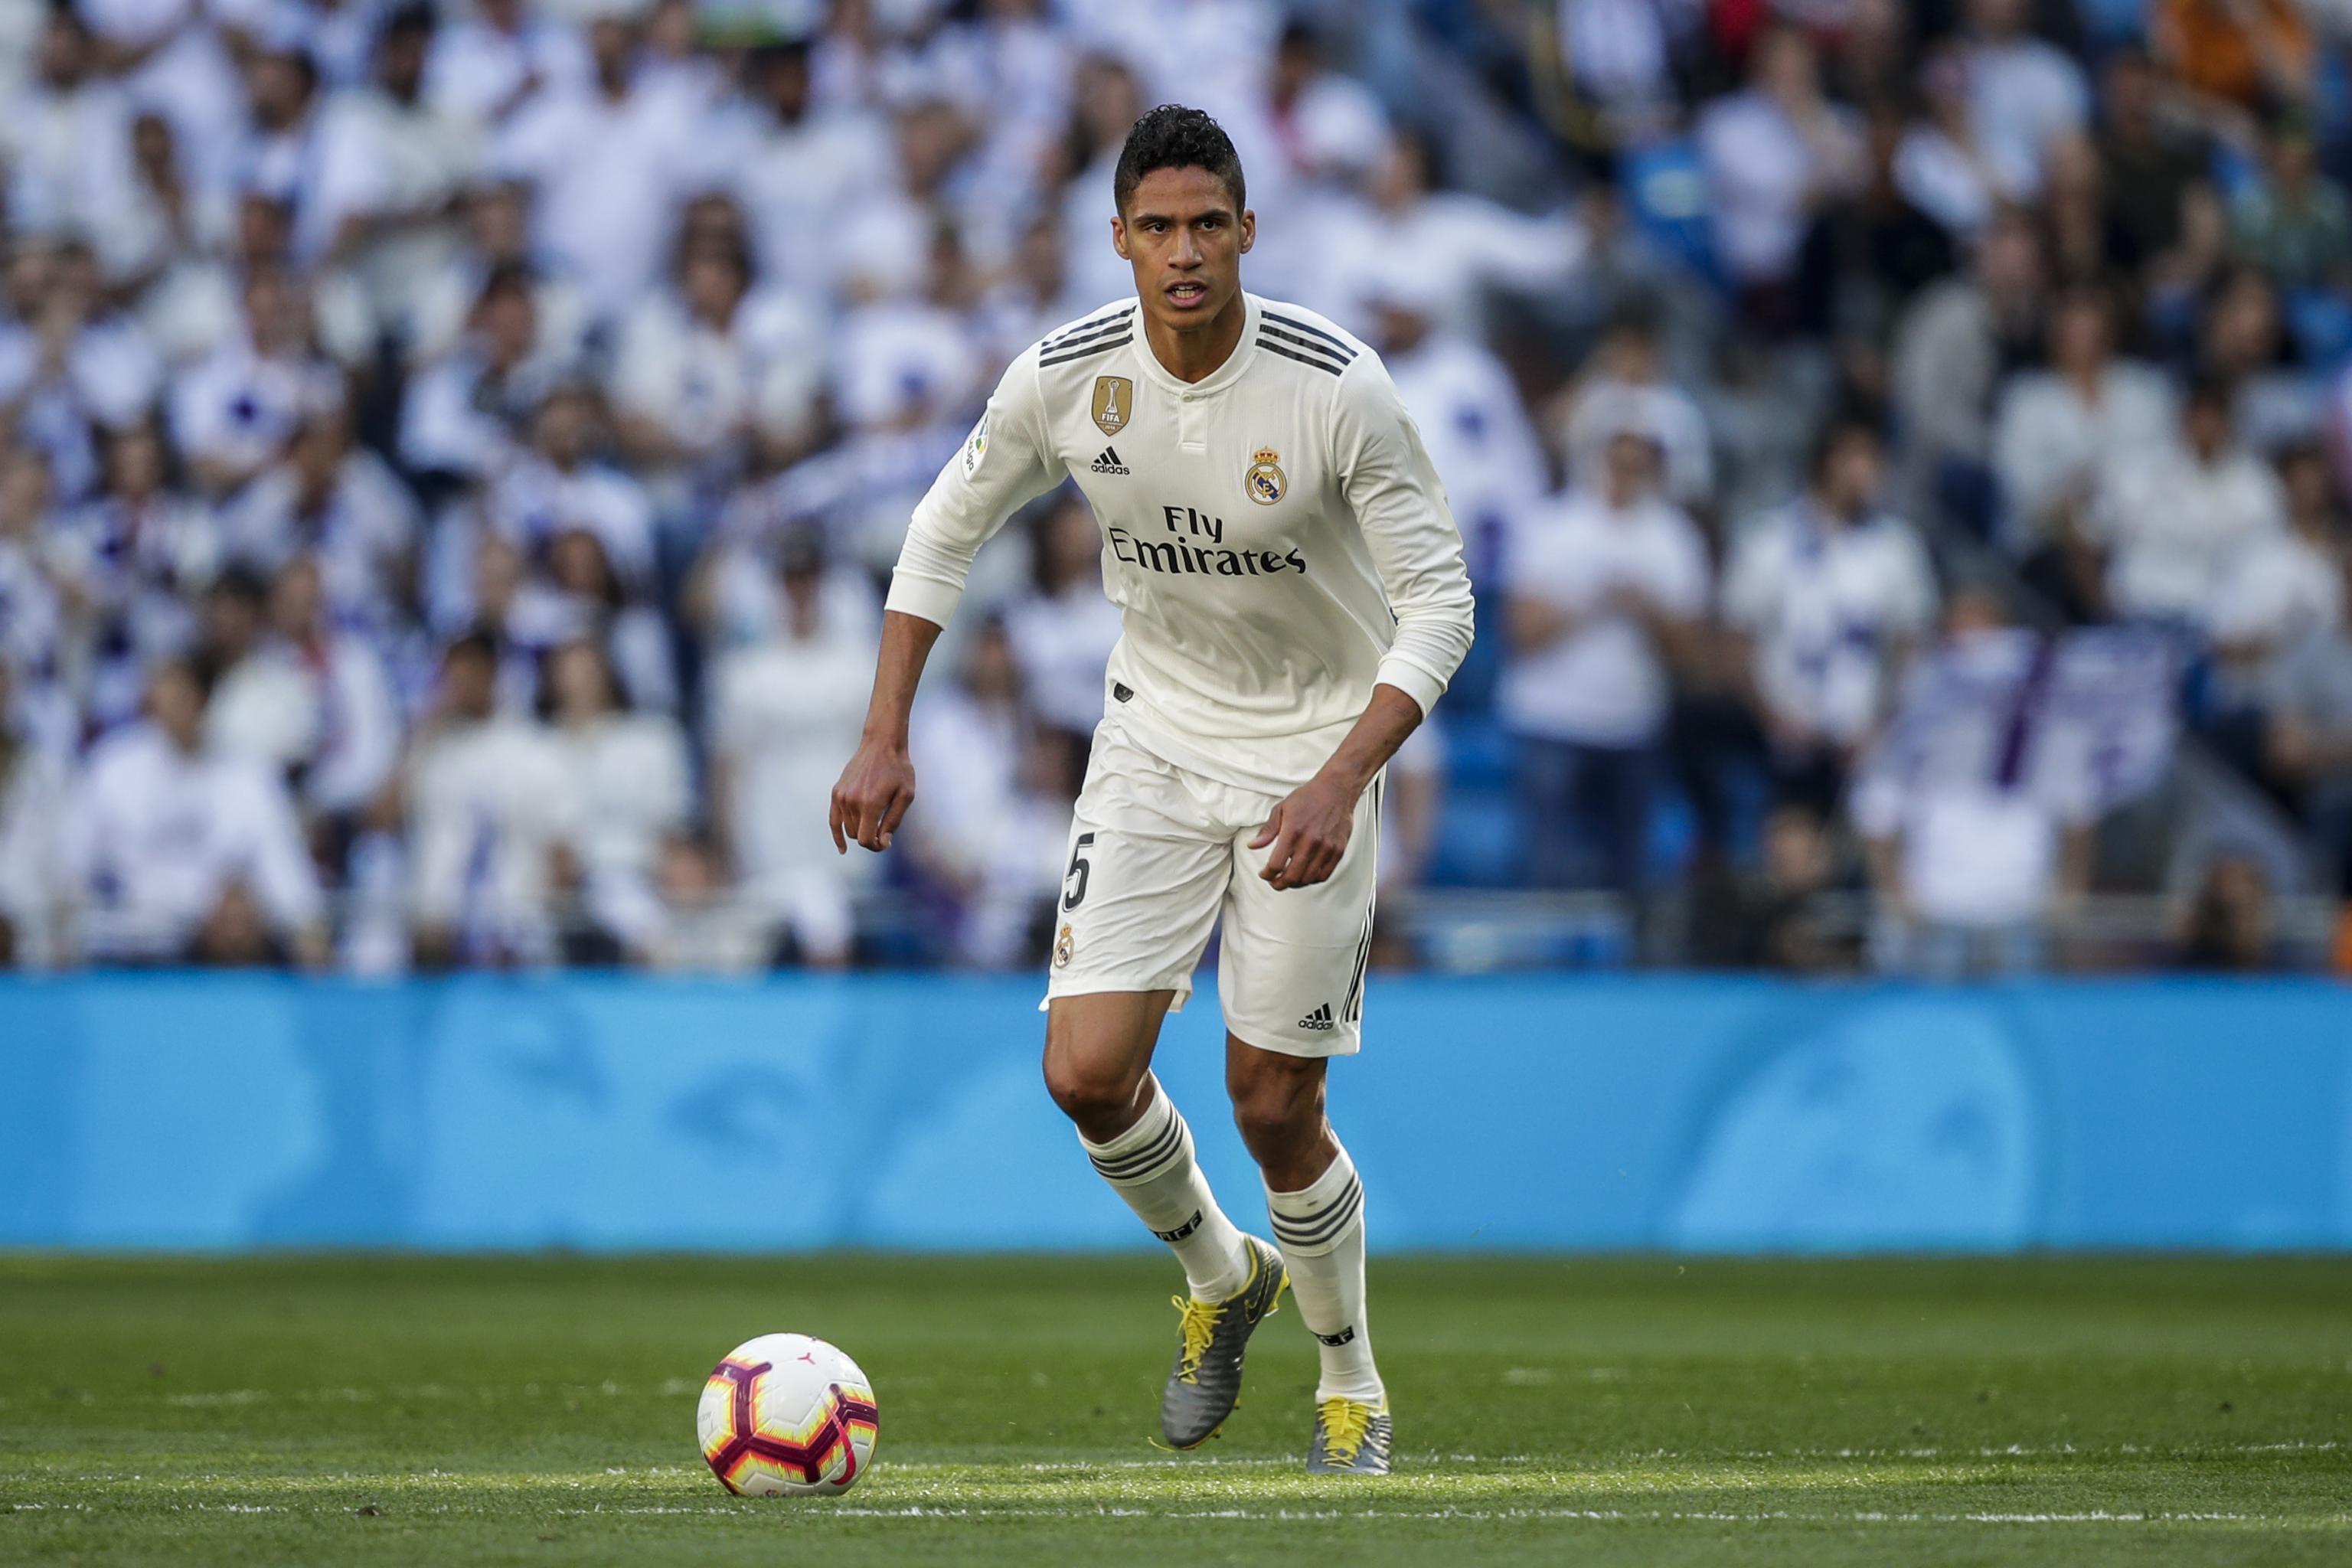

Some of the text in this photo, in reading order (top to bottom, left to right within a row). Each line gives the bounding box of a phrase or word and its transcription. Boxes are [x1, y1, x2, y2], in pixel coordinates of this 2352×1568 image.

[1102, 413, 1119, 423] FIFA
[1091, 464, 1130, 475] adidas
[1162, 505, 1223, 544] Fly
[1108, 526, 1306, 576] Emirates
[1062, 831, 1096, 913] 5
